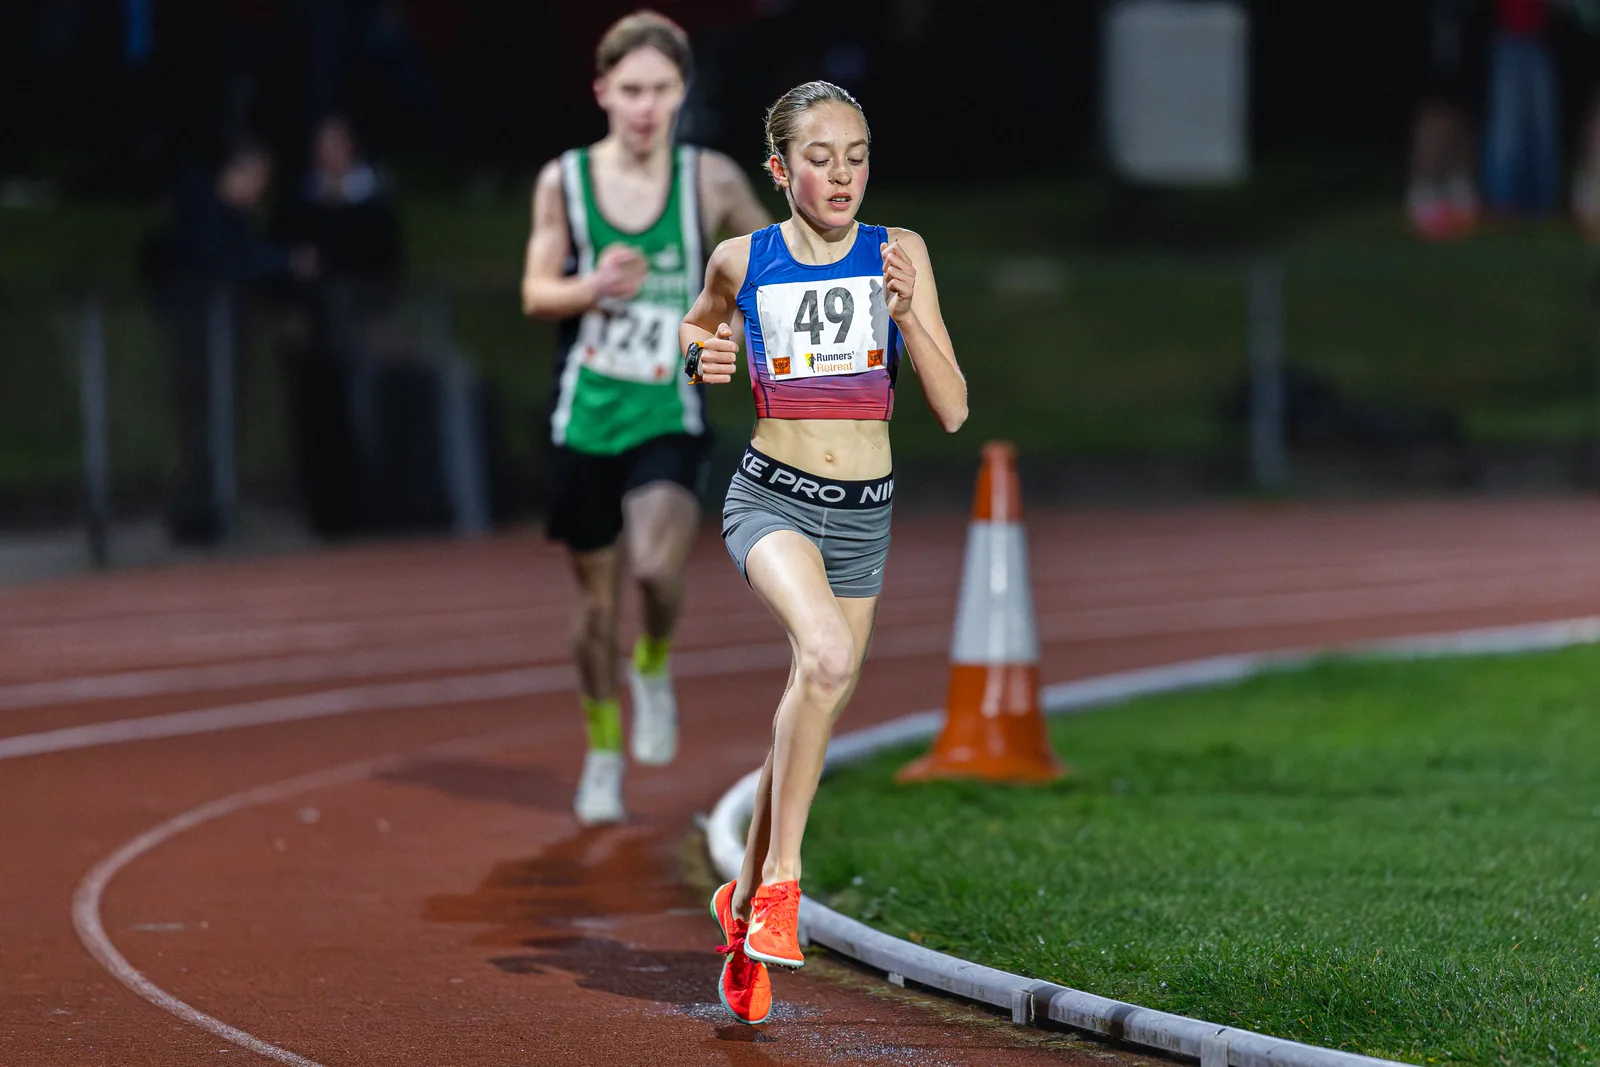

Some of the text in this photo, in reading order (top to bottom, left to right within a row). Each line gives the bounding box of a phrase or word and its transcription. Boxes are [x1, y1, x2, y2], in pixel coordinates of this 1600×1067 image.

[793, 286, 855, 346] 49
[816, 350, 855, 362] Runners'
[816, 361, 853, 373] Retreat
[740, 449, 770, 478] KE
[768, 467, 846, 503] PRO
